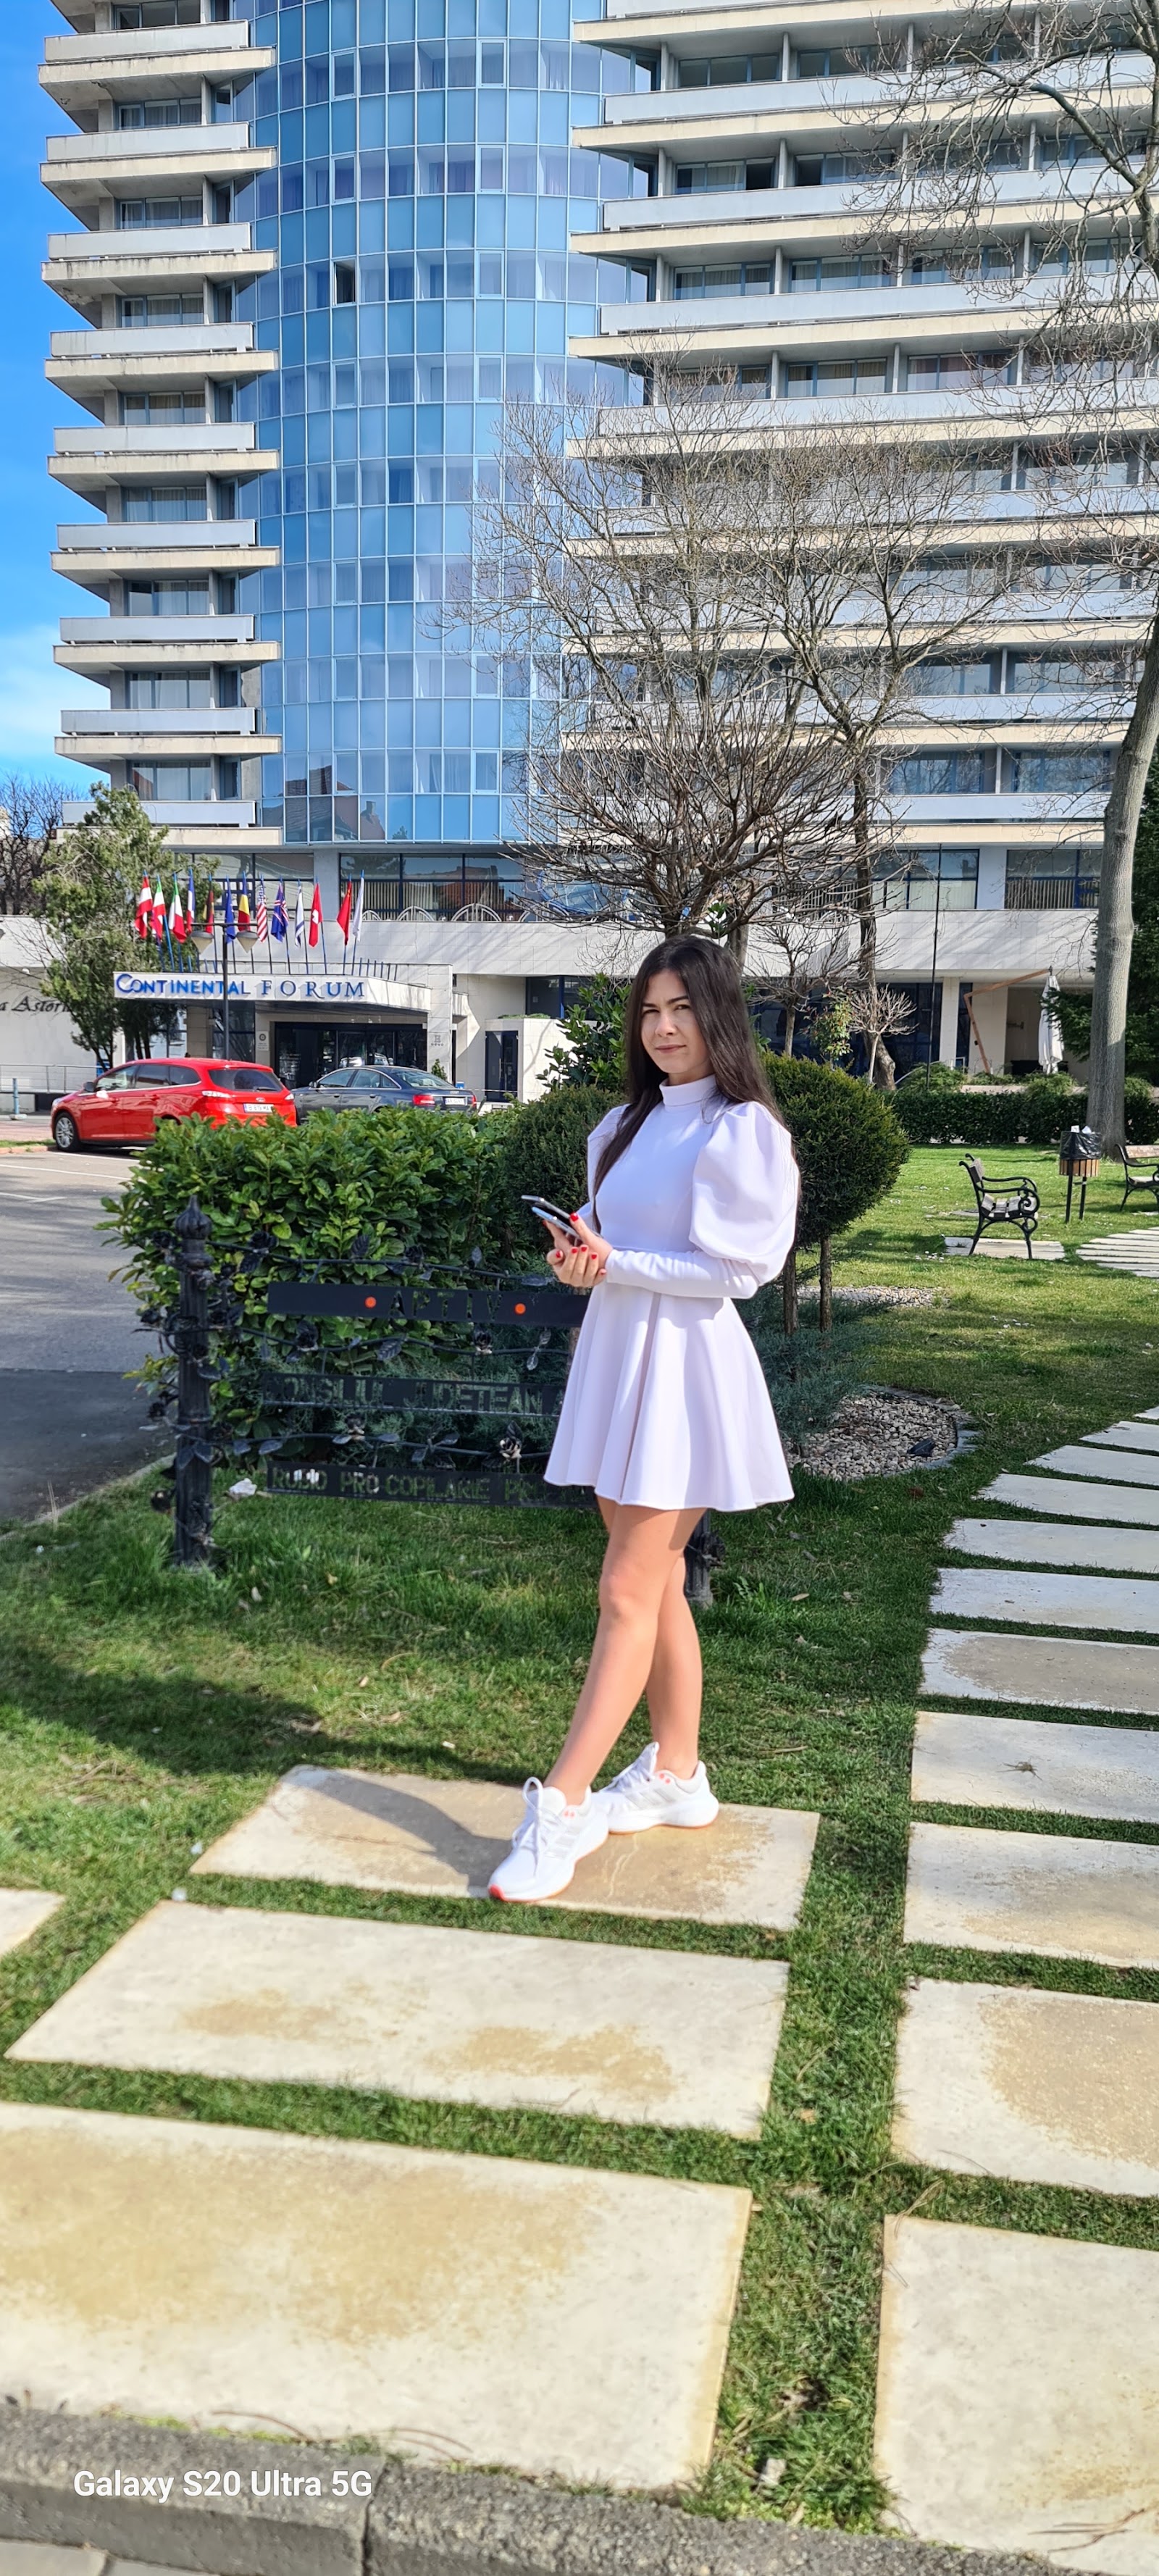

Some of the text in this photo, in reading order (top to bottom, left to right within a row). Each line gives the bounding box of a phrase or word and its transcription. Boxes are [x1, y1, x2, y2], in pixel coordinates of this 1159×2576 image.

[116, 973, 365, 999] CONTINENTAL FORUM
[12, 995, 71, 1012] Astori
[388, 1289, 503, 1322] APTIV
[339, 1471, 380, 1495] PRO
